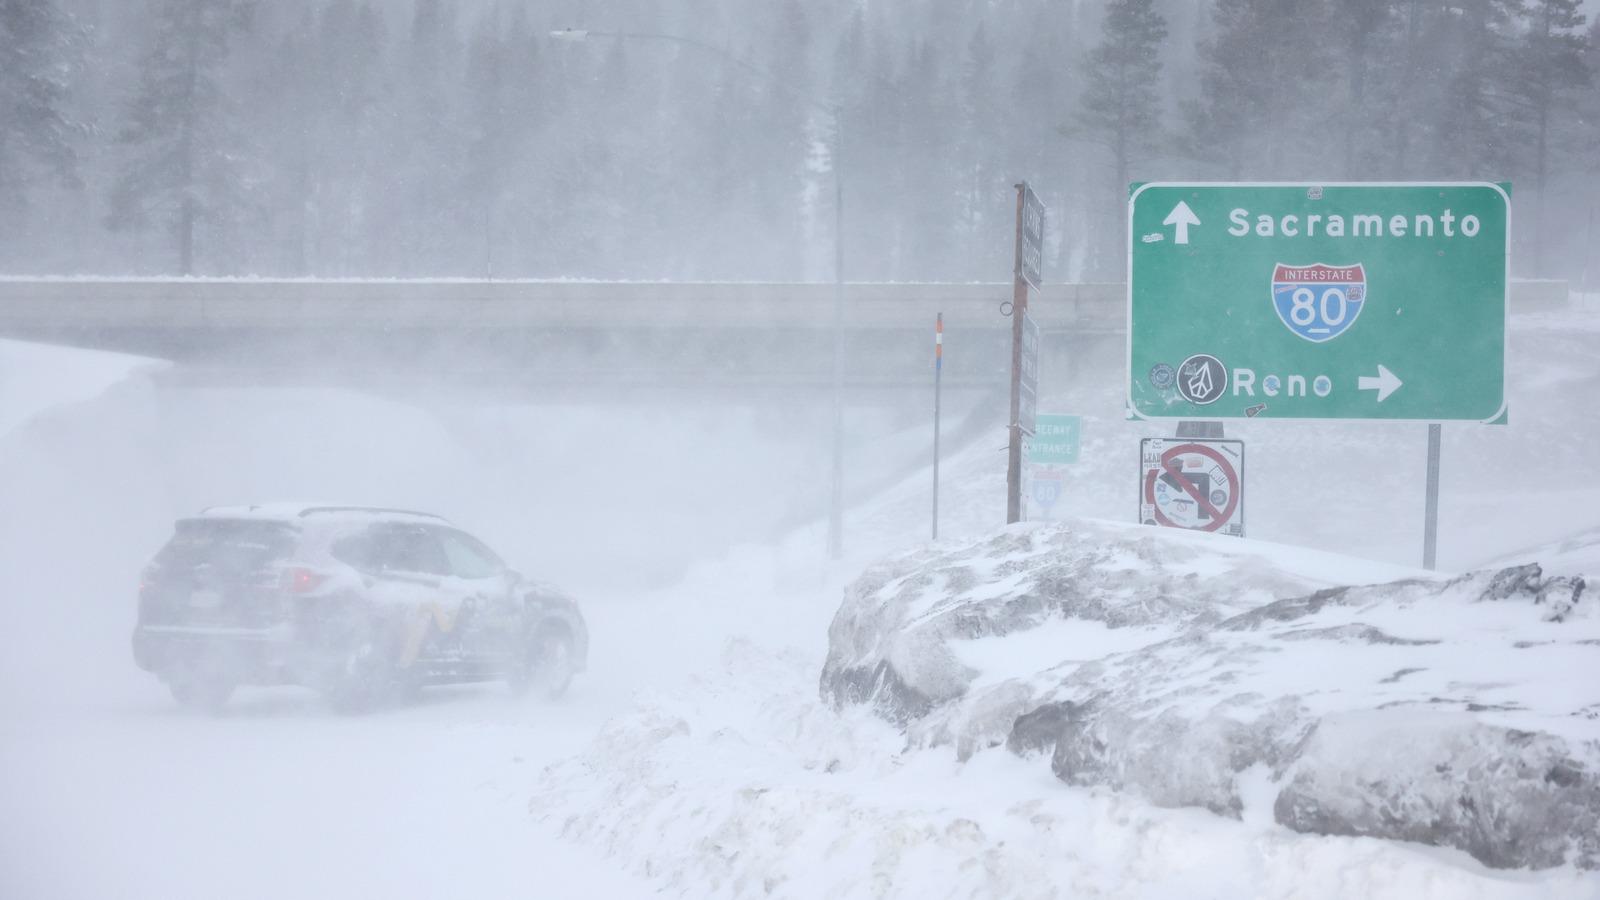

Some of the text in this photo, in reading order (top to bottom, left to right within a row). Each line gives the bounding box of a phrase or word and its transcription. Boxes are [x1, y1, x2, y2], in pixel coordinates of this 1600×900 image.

[1228, 208, 1481, 237] Sacramento
[1285, 270, 1353, 280] INTERSTATE
[1290, 287, 1347, 326] 80
[1233, 368, 1332, 397] Reno
[1035, 424, 1071, 434] REEWAY
[1031, 443, 1072, 455] NTRANCE
